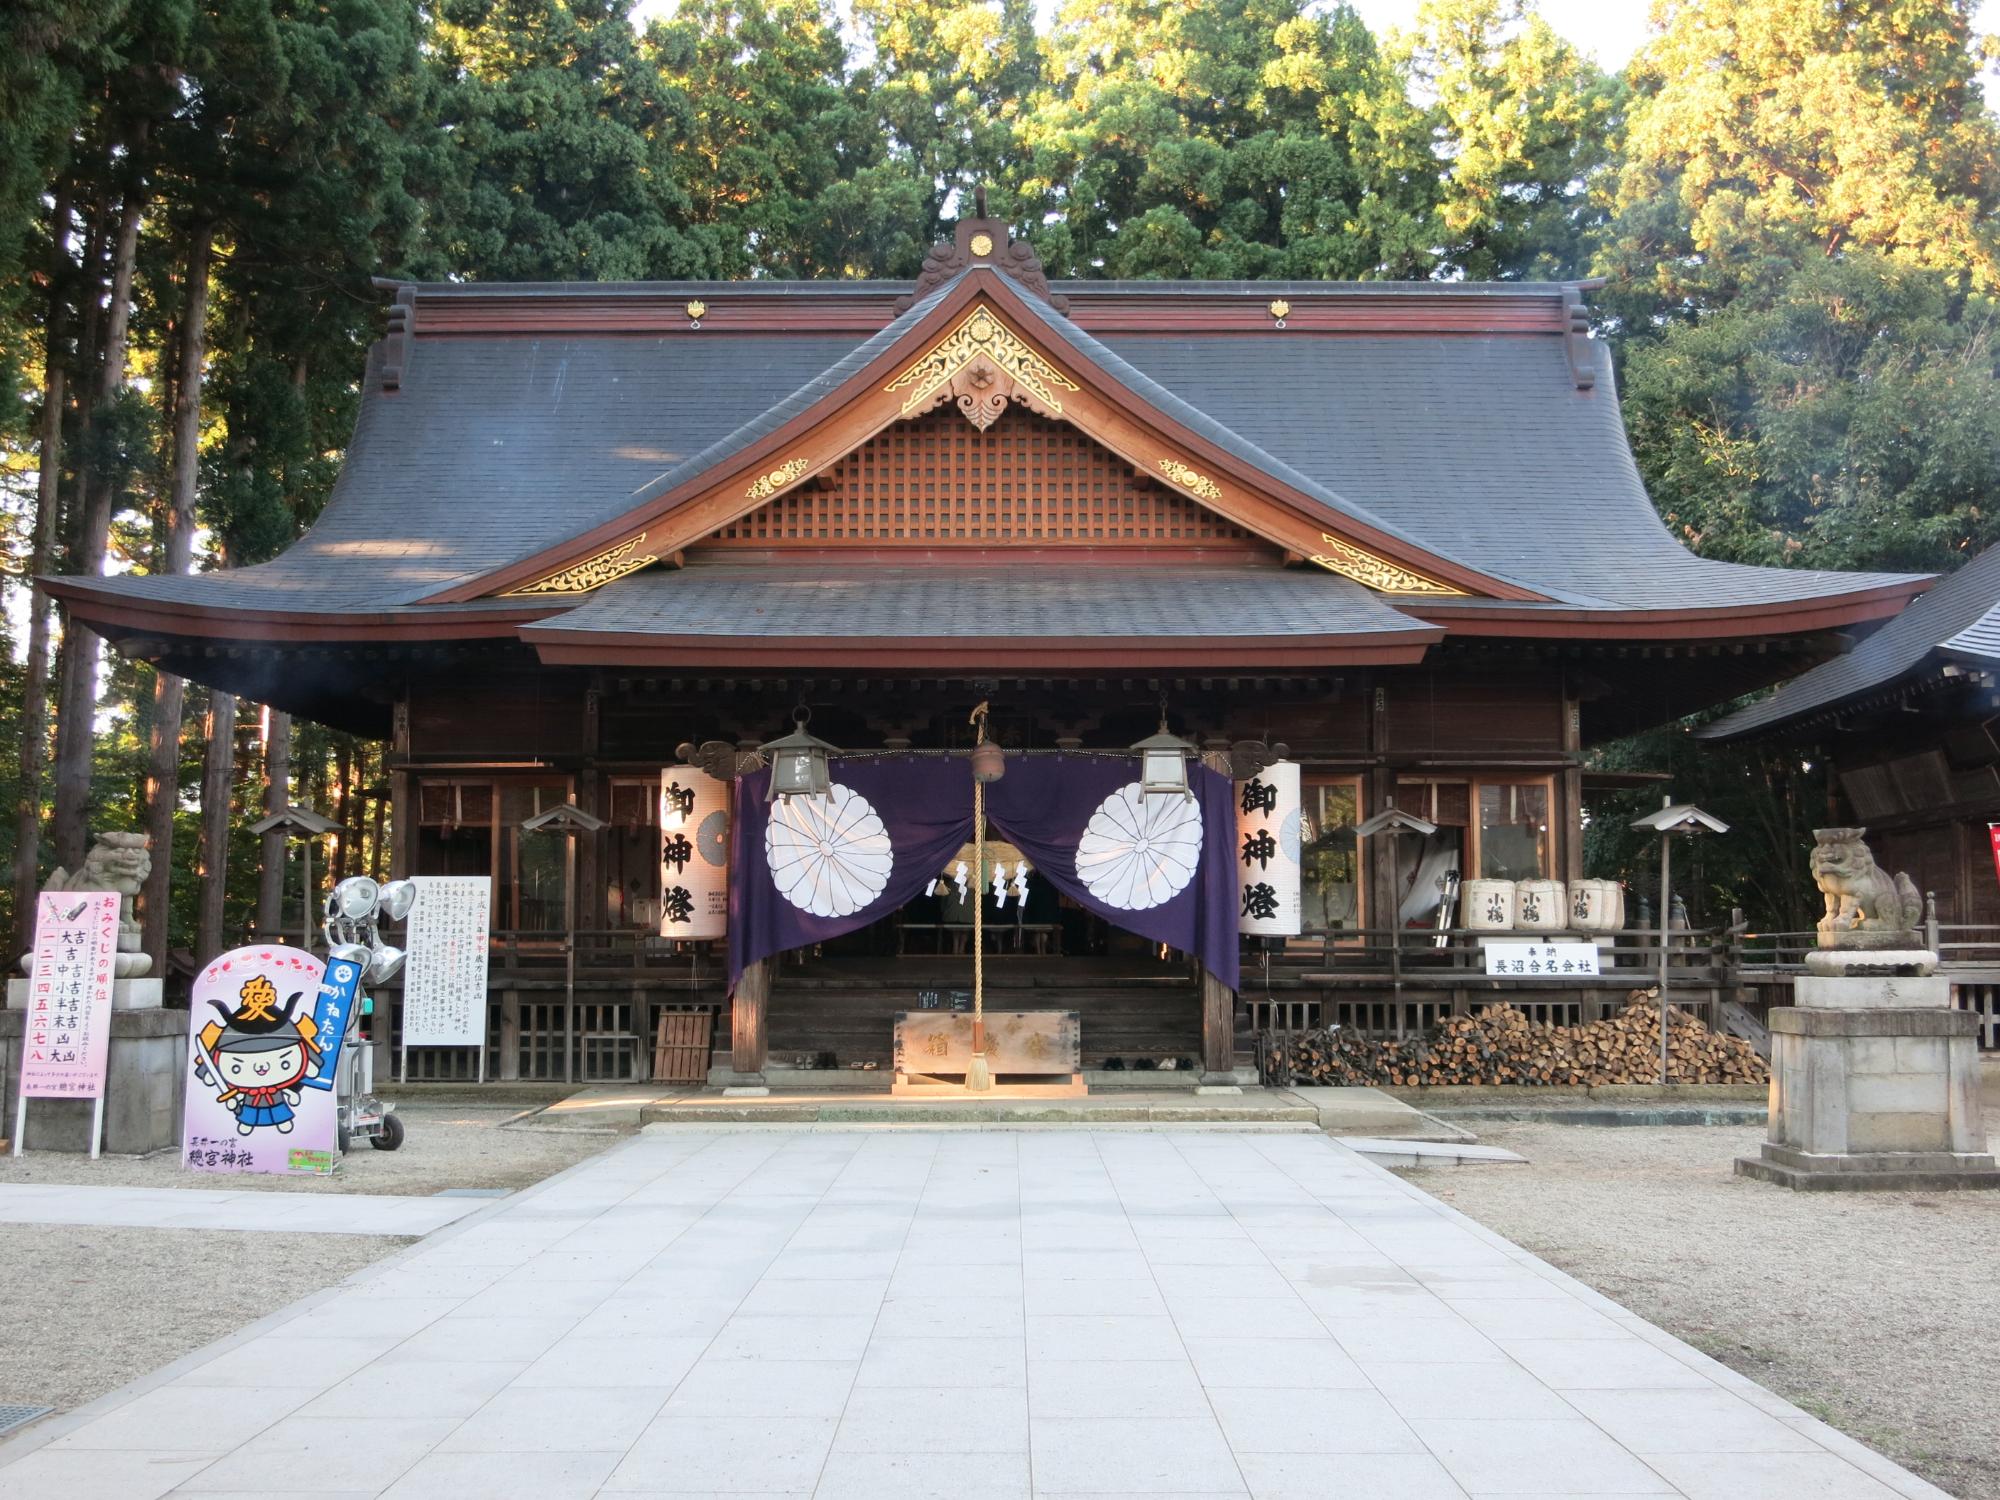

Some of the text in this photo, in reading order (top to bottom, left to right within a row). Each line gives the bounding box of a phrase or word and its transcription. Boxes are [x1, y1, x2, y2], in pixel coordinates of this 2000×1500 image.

[662, 781, 696, 923] 御神燈
[1241, 778, 1280, 920] 御神燈
[61, 930, 86, 945] 大吉
[66, 947, 78, 961] 吉
[95, 896, 115, 1001] おみくじの順位
[57, 964, 84, 979] 中吉
[1496, 960, 1593, 974] 長沼合名会社
[56, 981, 82, 995] 小吉
[55, 998, 80, 1012] 半吉
[237, 974, 277, 1022] 愛
[53, 1015, 79, 1029] 末吉
[319, 983, 346, 1052] かねたん
[56, 1033, 70, 1045] 凶
[50, 1049, 75, 1063] 大凶
